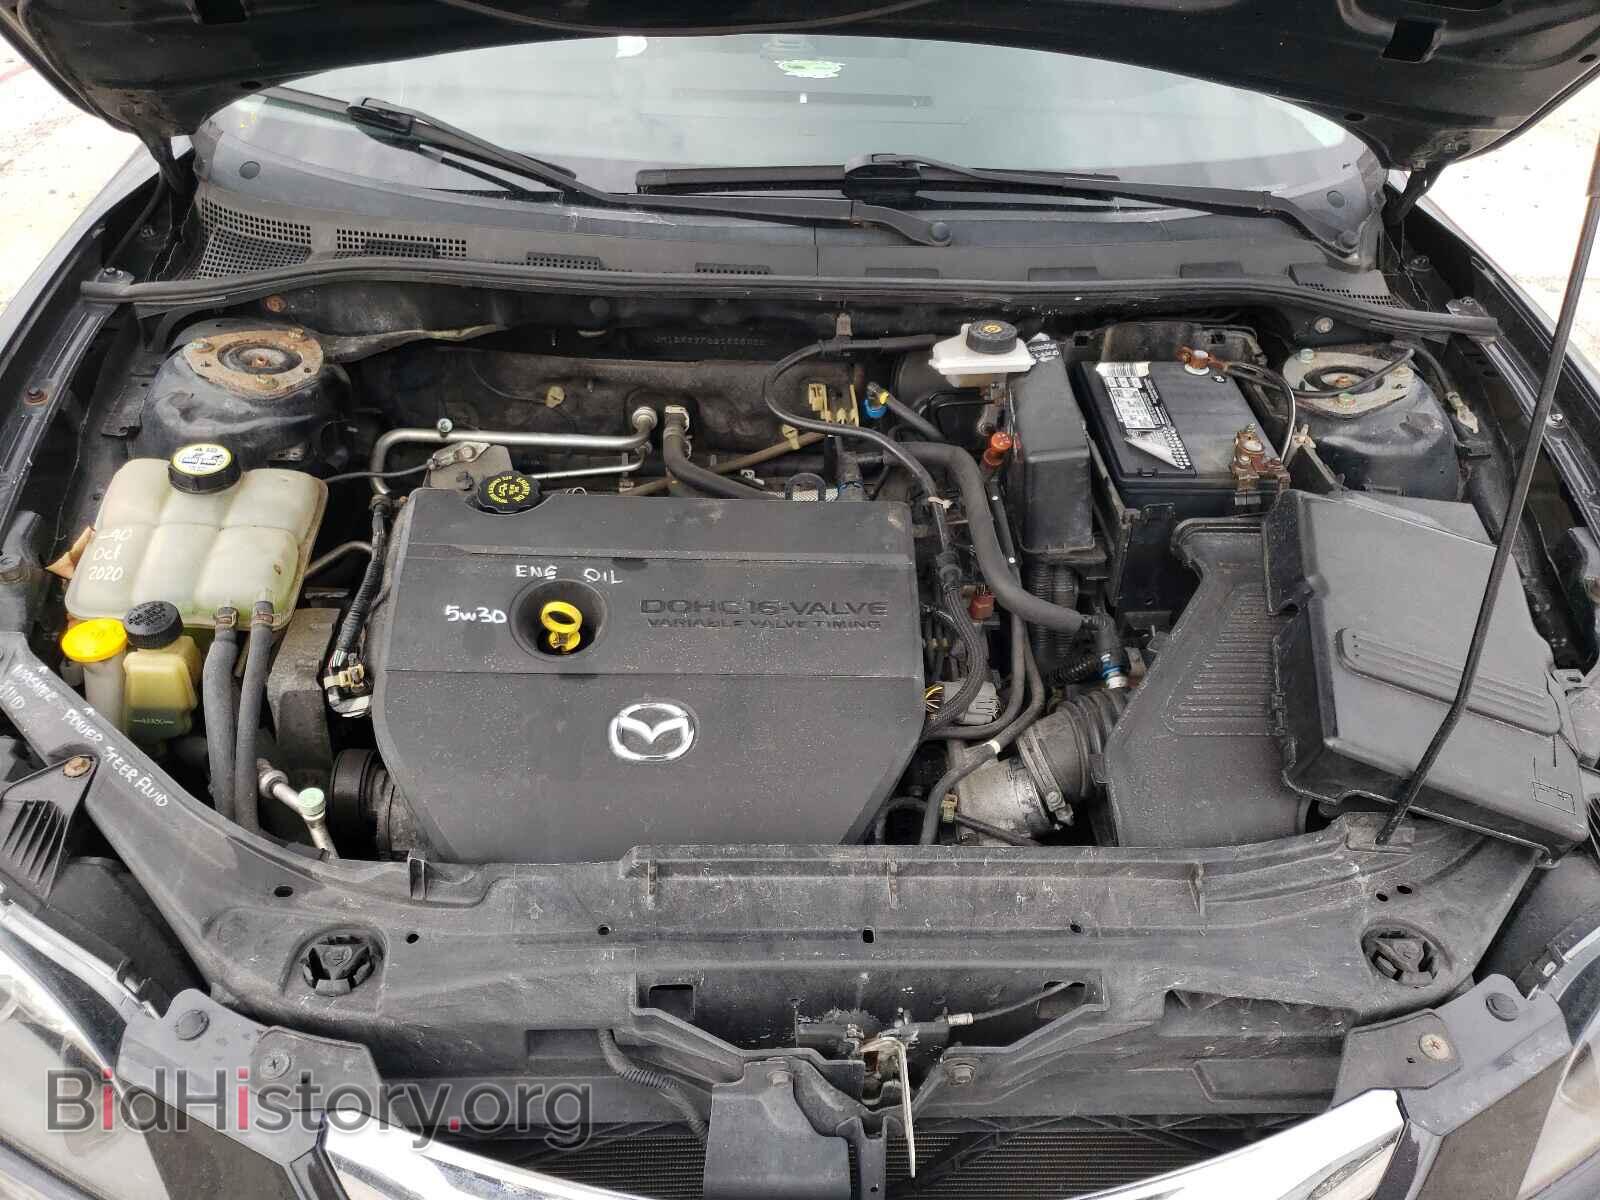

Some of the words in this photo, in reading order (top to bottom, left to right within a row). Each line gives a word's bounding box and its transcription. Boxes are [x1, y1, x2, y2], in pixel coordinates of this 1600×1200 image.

[88, 565, 124, 582] 2020
[515, 564, 558, 580] ENG
[583, 567, 624, 585] OIL
[640, 599, 745, 615] DOHC
[749, 618, 810, 630] VALVE
[813, 619, 882, 631] TIMING
[62, 708, 103, 744] POWER
[134, 776, 168, 807] FLUID
